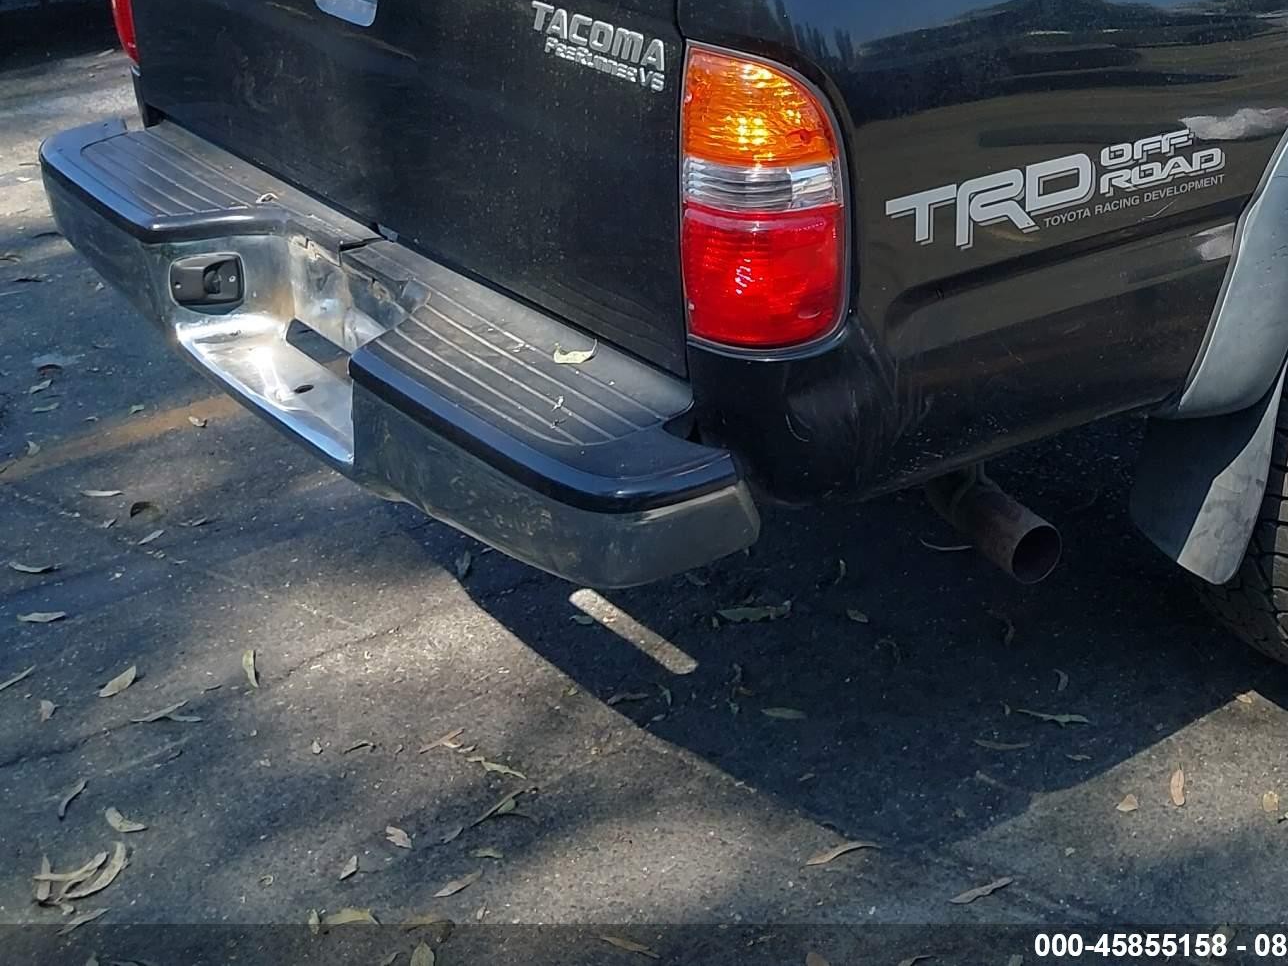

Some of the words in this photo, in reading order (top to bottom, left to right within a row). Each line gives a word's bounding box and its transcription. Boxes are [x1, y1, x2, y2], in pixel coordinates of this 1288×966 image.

[531, 0, 665, 71] TACOMA
[639, 67, 665, 92] V6
[1100, 147, 1226, 197] ROAD
[1101, 129, 1195, 170] OFF
[885, 153, 1096, 249] TRD
[1043, 207, 1092, 228] TOYOTA
[1094, 195, 1141, 216] RACING
[1143, 173, 1226, 203] DEVELOPMENT
